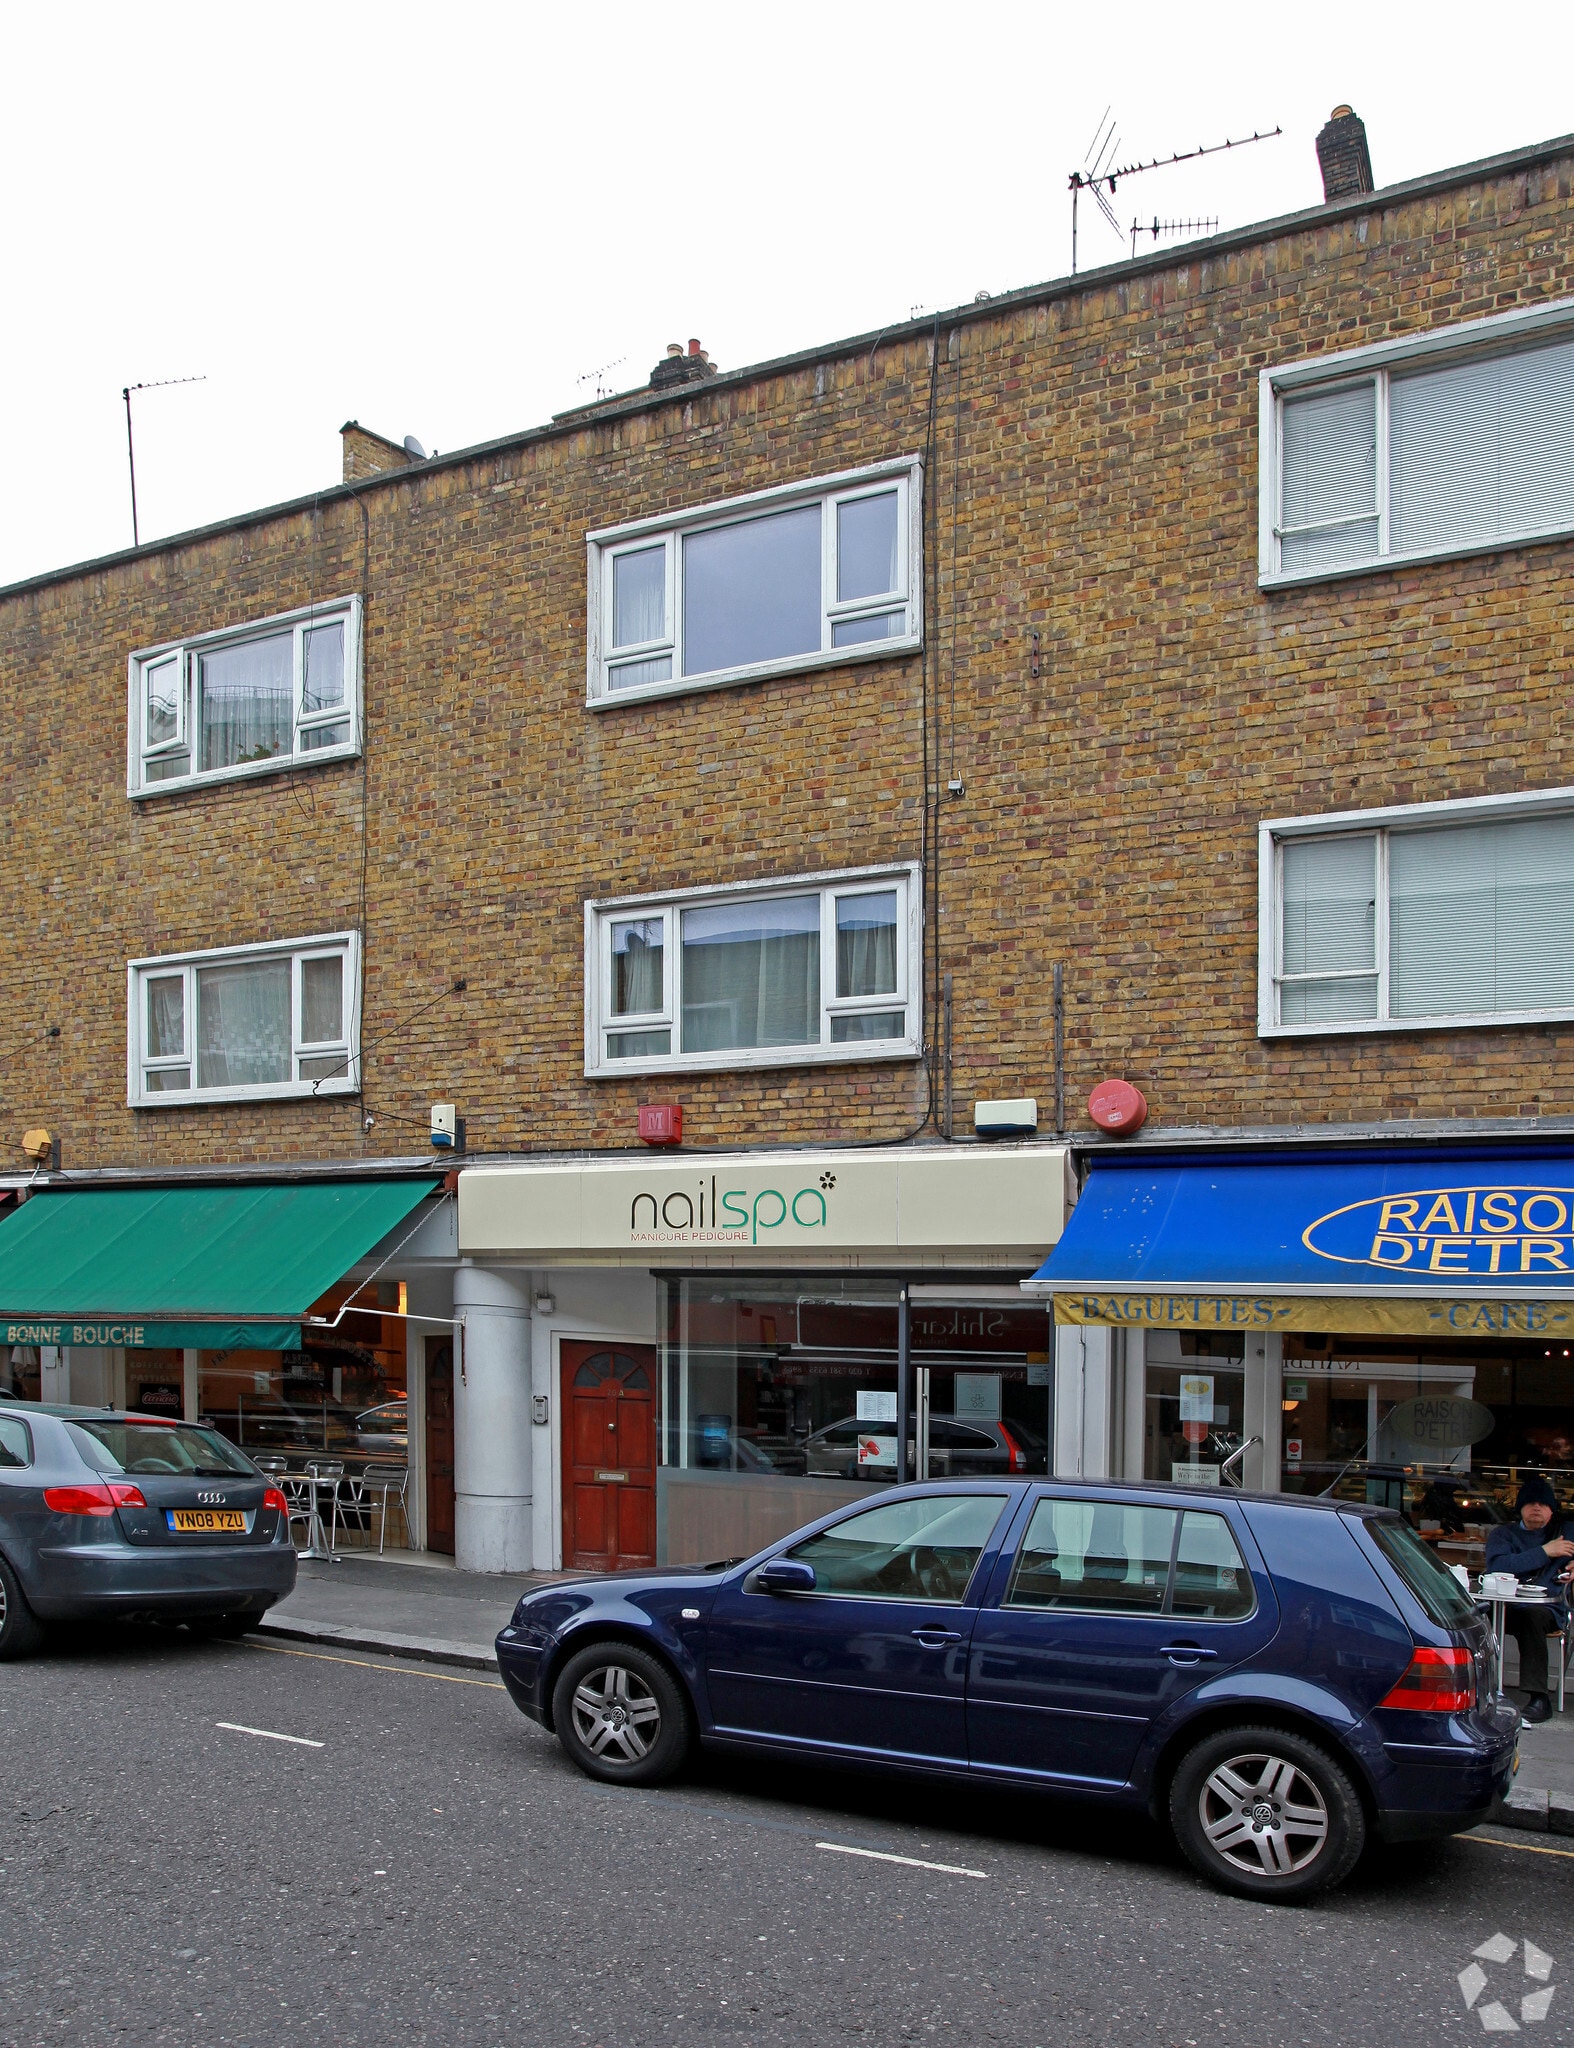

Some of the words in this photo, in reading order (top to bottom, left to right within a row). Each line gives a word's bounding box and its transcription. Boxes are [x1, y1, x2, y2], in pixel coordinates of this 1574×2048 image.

[646, 1111, 664, 1131] M
[631, 1174, 827, 1245] nailspa
[1378, 1192, 1574, 1233] RAISO
[630, 1232, 689, 1241] MANICURE
[692, 1231, 749, 1241] PEDICURE
[1369, 1235, 1574, 1273] D'ETR
[7, 1325, 62, 1344] BONNE
[72, 1325, 145, 1345] BOUCHE
[1413, 1400, 1473, 1419] RAISON
[1413, 1420, 1473, 1441] D'ETRE
[175, 1512, 214, 1528] VN08
[214, 1513, 244, 1528] YZU
